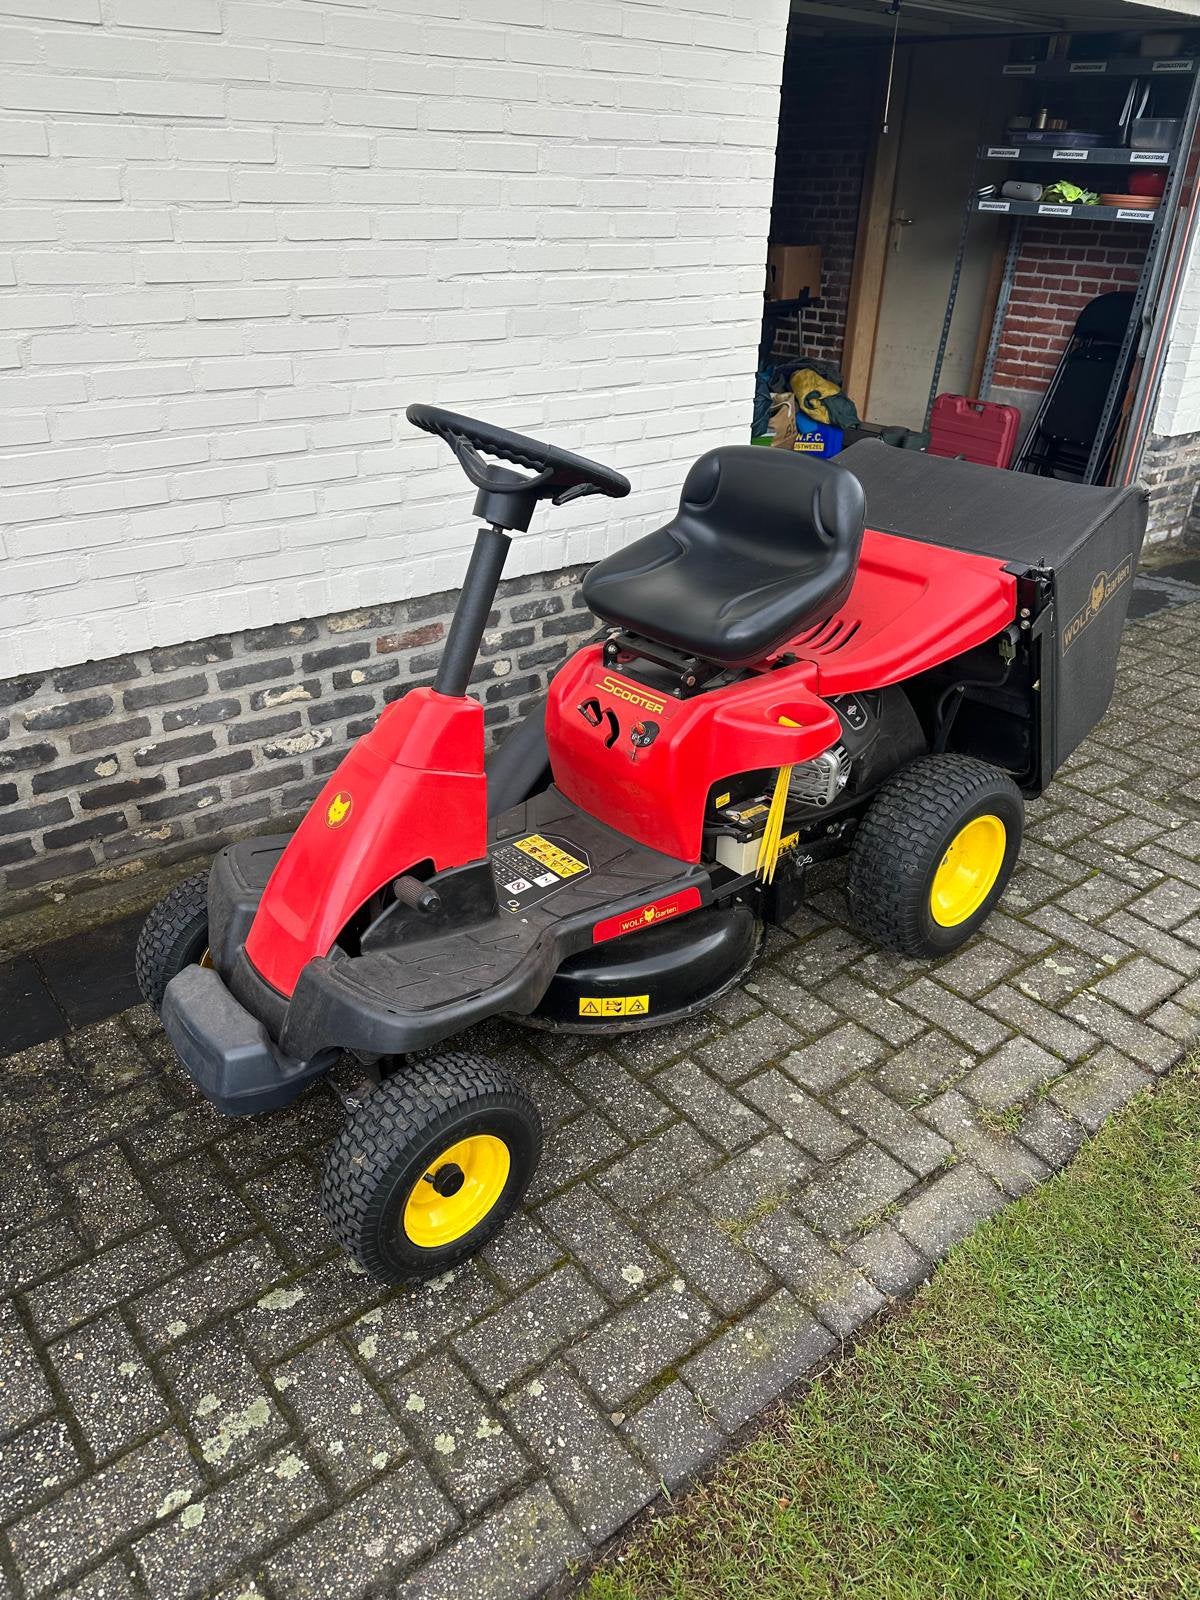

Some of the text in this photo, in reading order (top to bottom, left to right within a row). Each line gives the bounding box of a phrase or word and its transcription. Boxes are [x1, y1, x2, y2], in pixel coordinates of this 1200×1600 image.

[1065, 565, 1130, 645] WOLF Garten
[595, 676, 667, 715] SCOOTER
[621, 906, 677, 930] WOLF Garten
